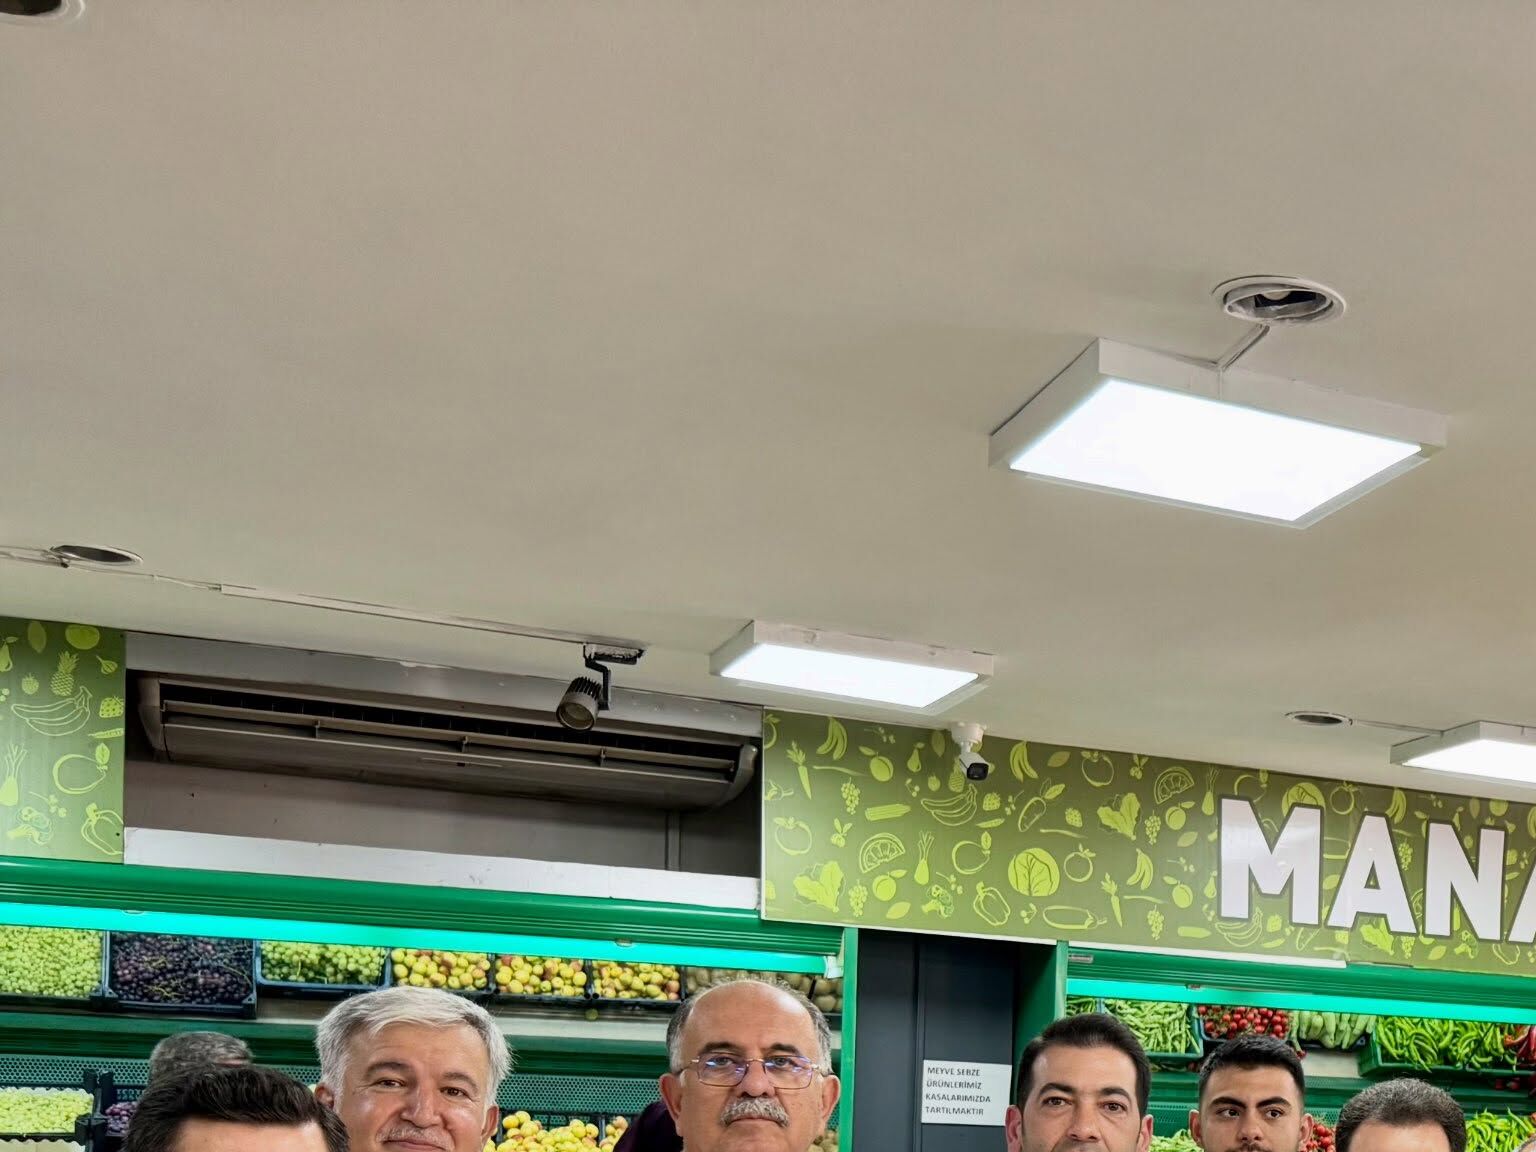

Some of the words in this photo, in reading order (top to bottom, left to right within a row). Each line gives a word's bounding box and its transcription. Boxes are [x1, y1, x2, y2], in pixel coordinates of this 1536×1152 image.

[927, 1067, 955, 1075] MEYVE
[956, 1069, 980, 1077] SEBZE
[925, 1106, 984, 1116] TARTILMAKTIR
